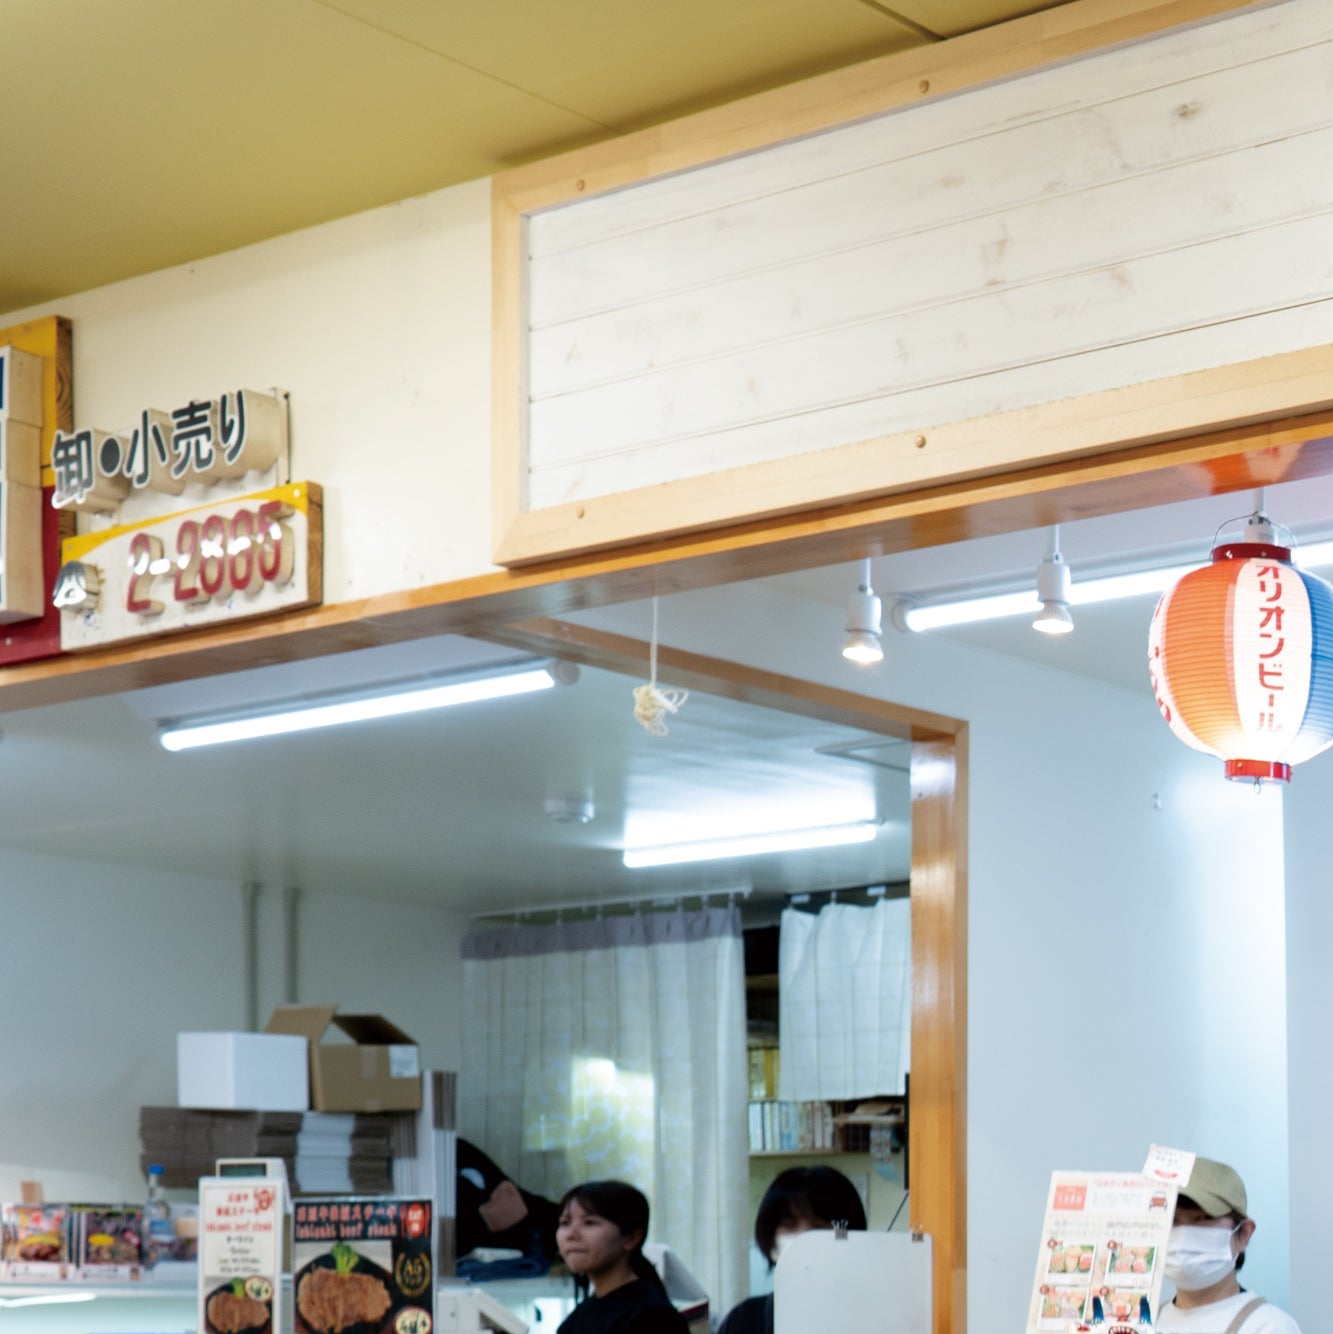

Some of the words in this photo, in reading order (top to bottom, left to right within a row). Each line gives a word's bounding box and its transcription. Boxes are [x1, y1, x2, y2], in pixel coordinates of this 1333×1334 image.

[1257, 564, 1286, 732] オリオンビール
